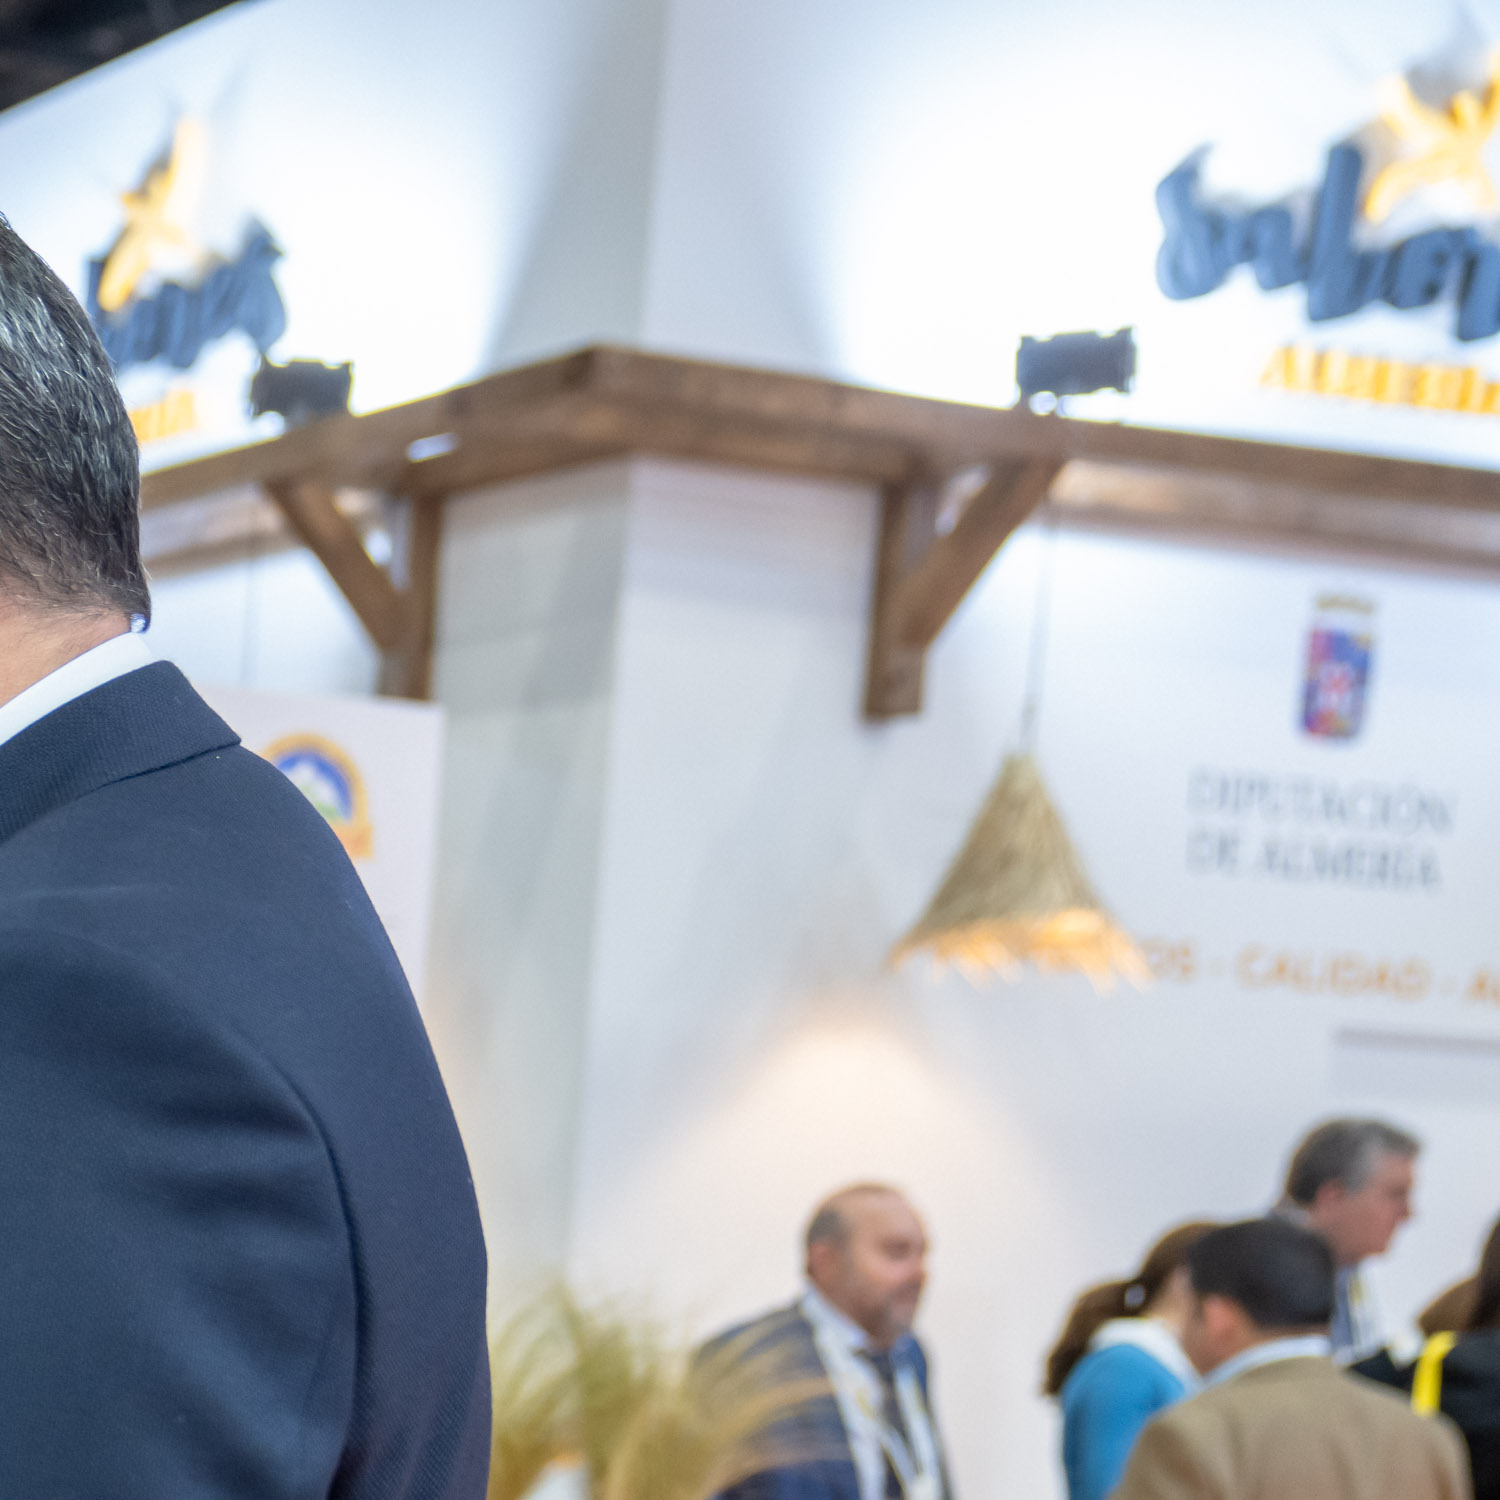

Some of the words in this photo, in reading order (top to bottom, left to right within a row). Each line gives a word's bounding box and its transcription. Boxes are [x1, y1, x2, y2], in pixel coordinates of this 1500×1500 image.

[1185, 764, 1459, 839] DIPUTACIÓN
[1184, 822, 1242, 879] DE
[1253, 834, 1444, 894] ALMERÍA
[1235, 942, 1431, 1003] CALIDAD
